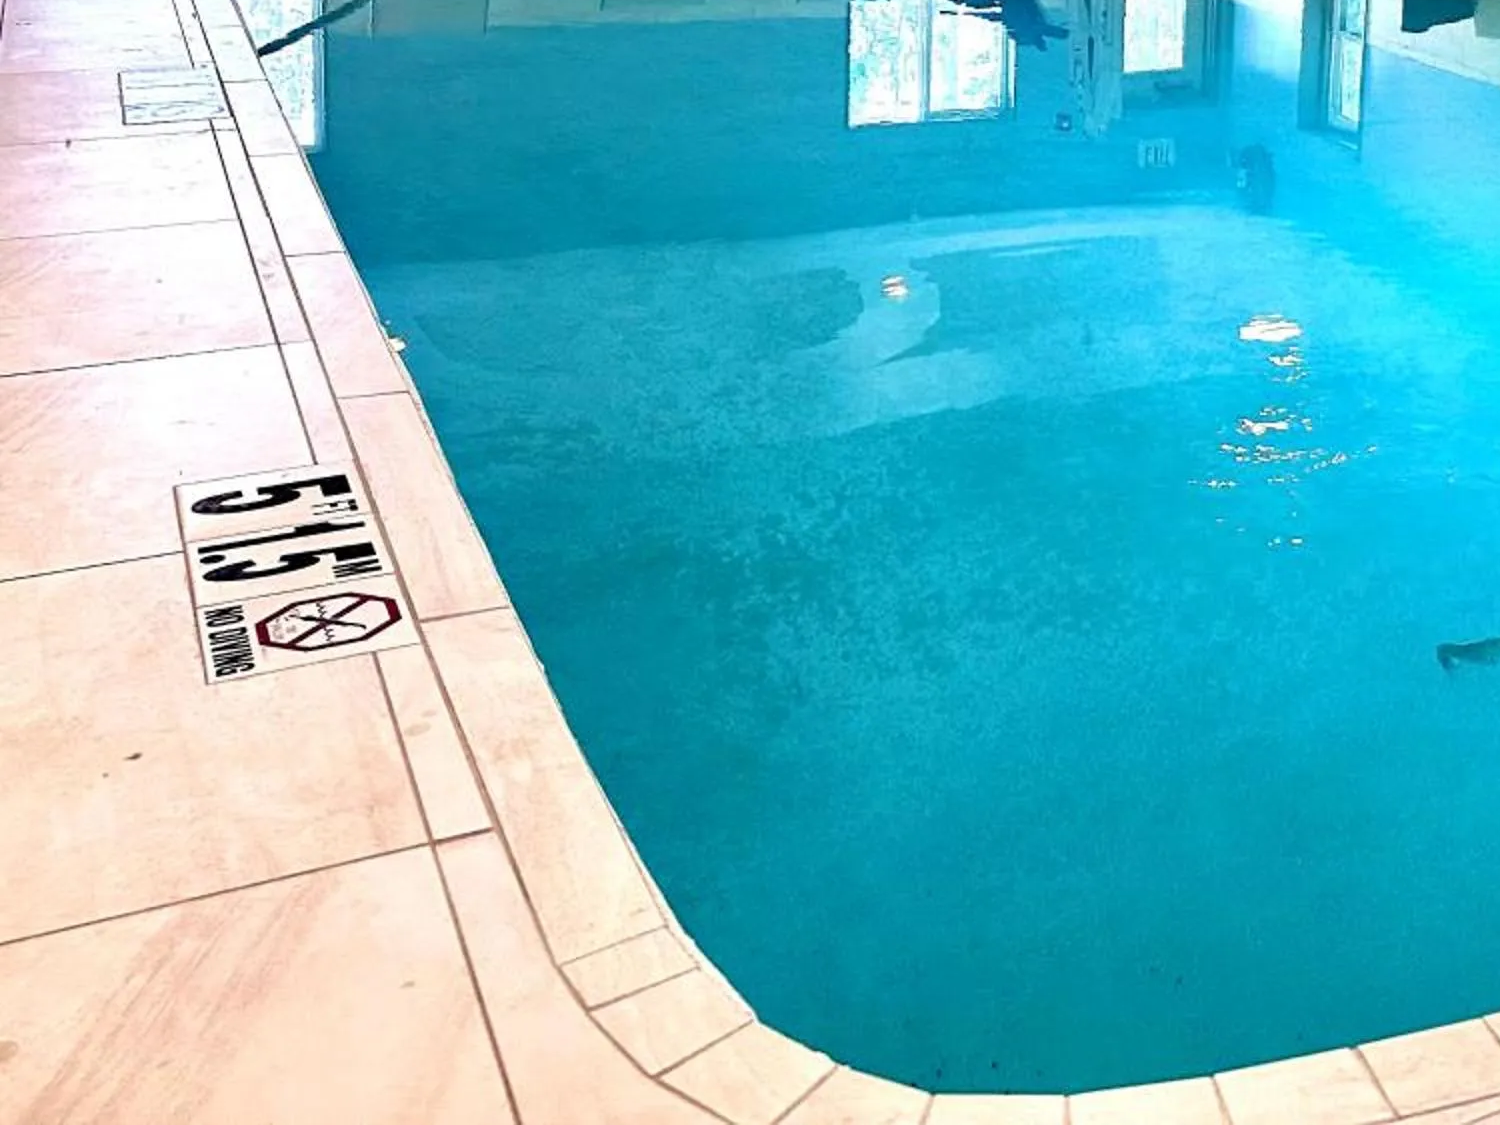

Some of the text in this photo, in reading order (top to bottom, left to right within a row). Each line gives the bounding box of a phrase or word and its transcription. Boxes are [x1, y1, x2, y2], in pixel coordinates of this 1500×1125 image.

[191, 474, 352, 515] 5
[332, 558, 383, 578] M
[204, 605, 256, 678] NO DIVING
